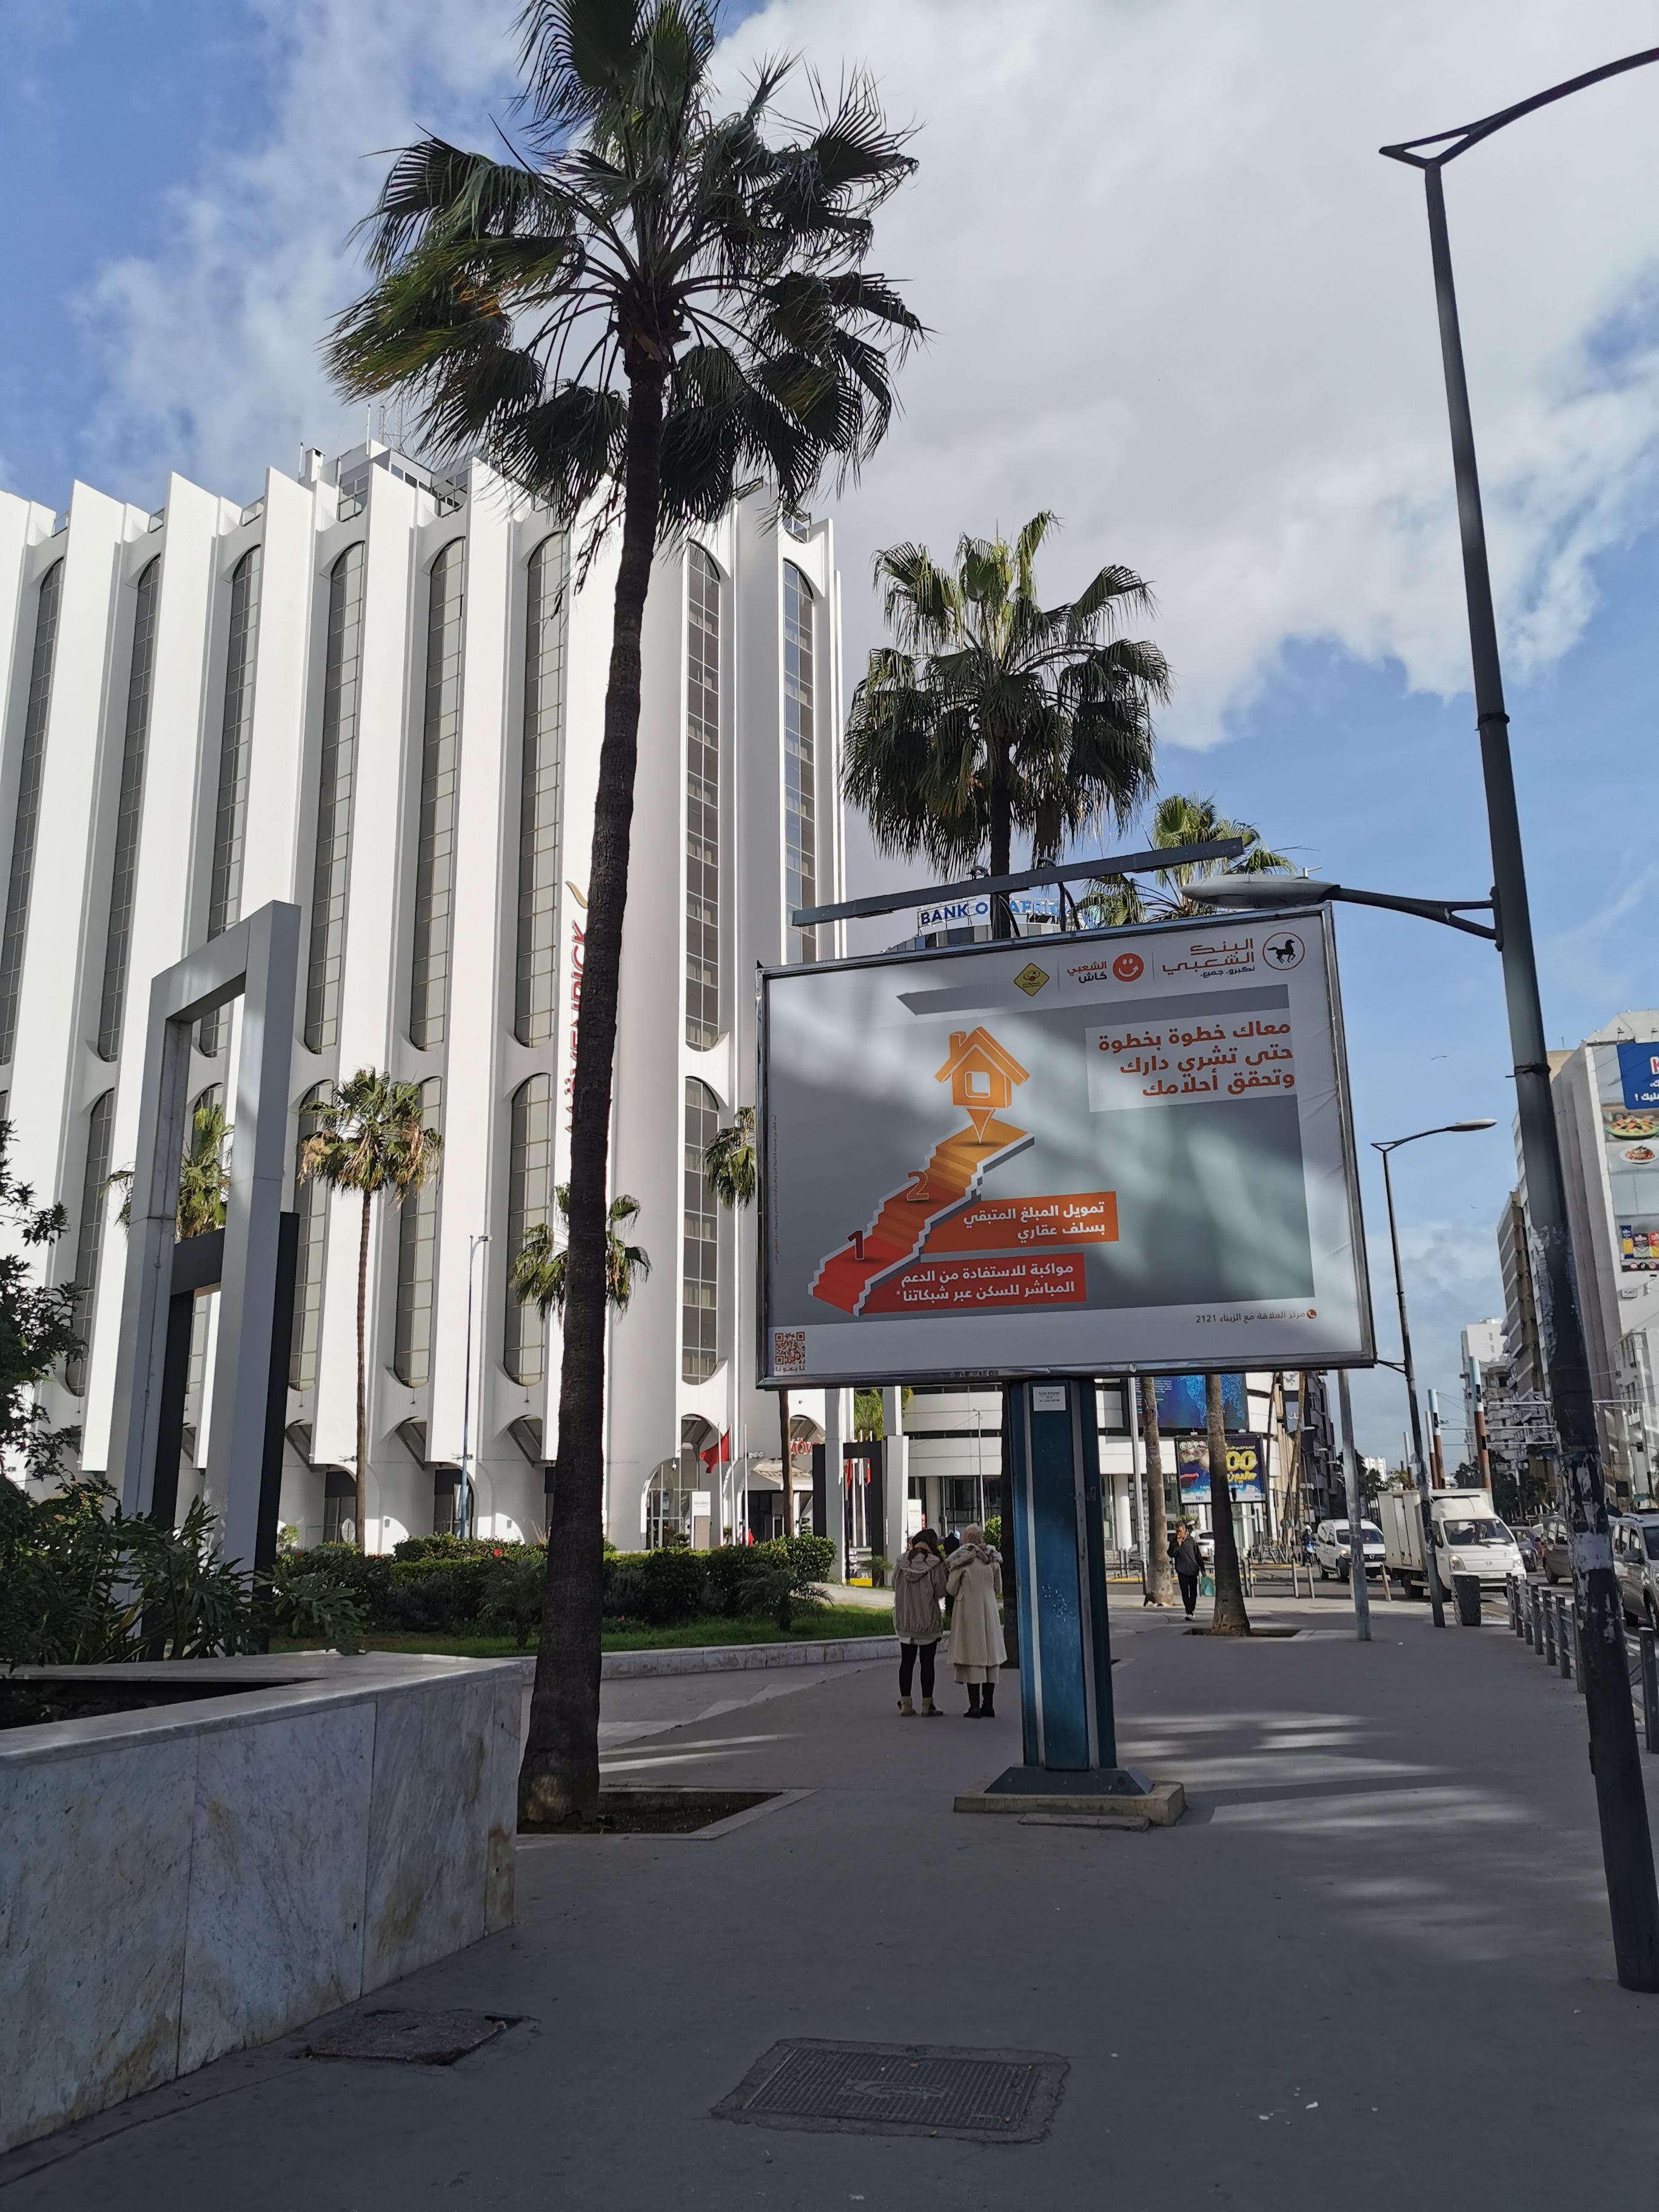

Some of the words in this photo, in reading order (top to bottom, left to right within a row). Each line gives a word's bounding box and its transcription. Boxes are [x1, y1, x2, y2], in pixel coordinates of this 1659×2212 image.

[920, 903, 970, 925] BANK
[1190, 938, 1253, 956] البنك
[1067, 960, 1107, 976] الشعبي
[1162, 951, 1255, 976] الشعبي
[1079, 971, 1107, 984] كاش
[1168, 1024, 1226, 1047] خطوة
[1233, 1021, 1291, 1038] معاك
[1099, 1031, 1161, 1054] بخطوة
[1178, 1045, 1238, 1078] تشري
[1245, 1044, 1293, 1066] حتى
[1120, 1056, 1168, 1076] دارك
[1142, 1068, 1218, 1096] أحلامك
[1227, 1069, 1295, 1095] وتحقق
[907, 1171, 929, 1201] 2
[964, 1208, 1016, 1228] المتبقي
[1021, 1205, 1059, 1222] المبلغ
[1063, 1201, 1105, 1218] تمويل
[1017, 1224, 1057, 1243] عقاري
[1062, 1222, 1105, 1235] بسلف
[846, 1229, 865, 1261] 1
[901, 1270, 935, 1288] الدعم
[939, 1271, 959, 1283] من
[963, 1265, 1026, 1279] للاستفادة
[1031, 1263, 1073, 1278] مواكبة
[953, 1290, 972, 1302] عبر
[976, 1284, 1019, 1299] للسكن
[1024, 1280, 1074, 1298] المباشر
[1196, 1315, 1216, 1324] 2121
[1244, 1315, 1255, 1324] مع
[1289, 1311, 1305, 1319] مركز
